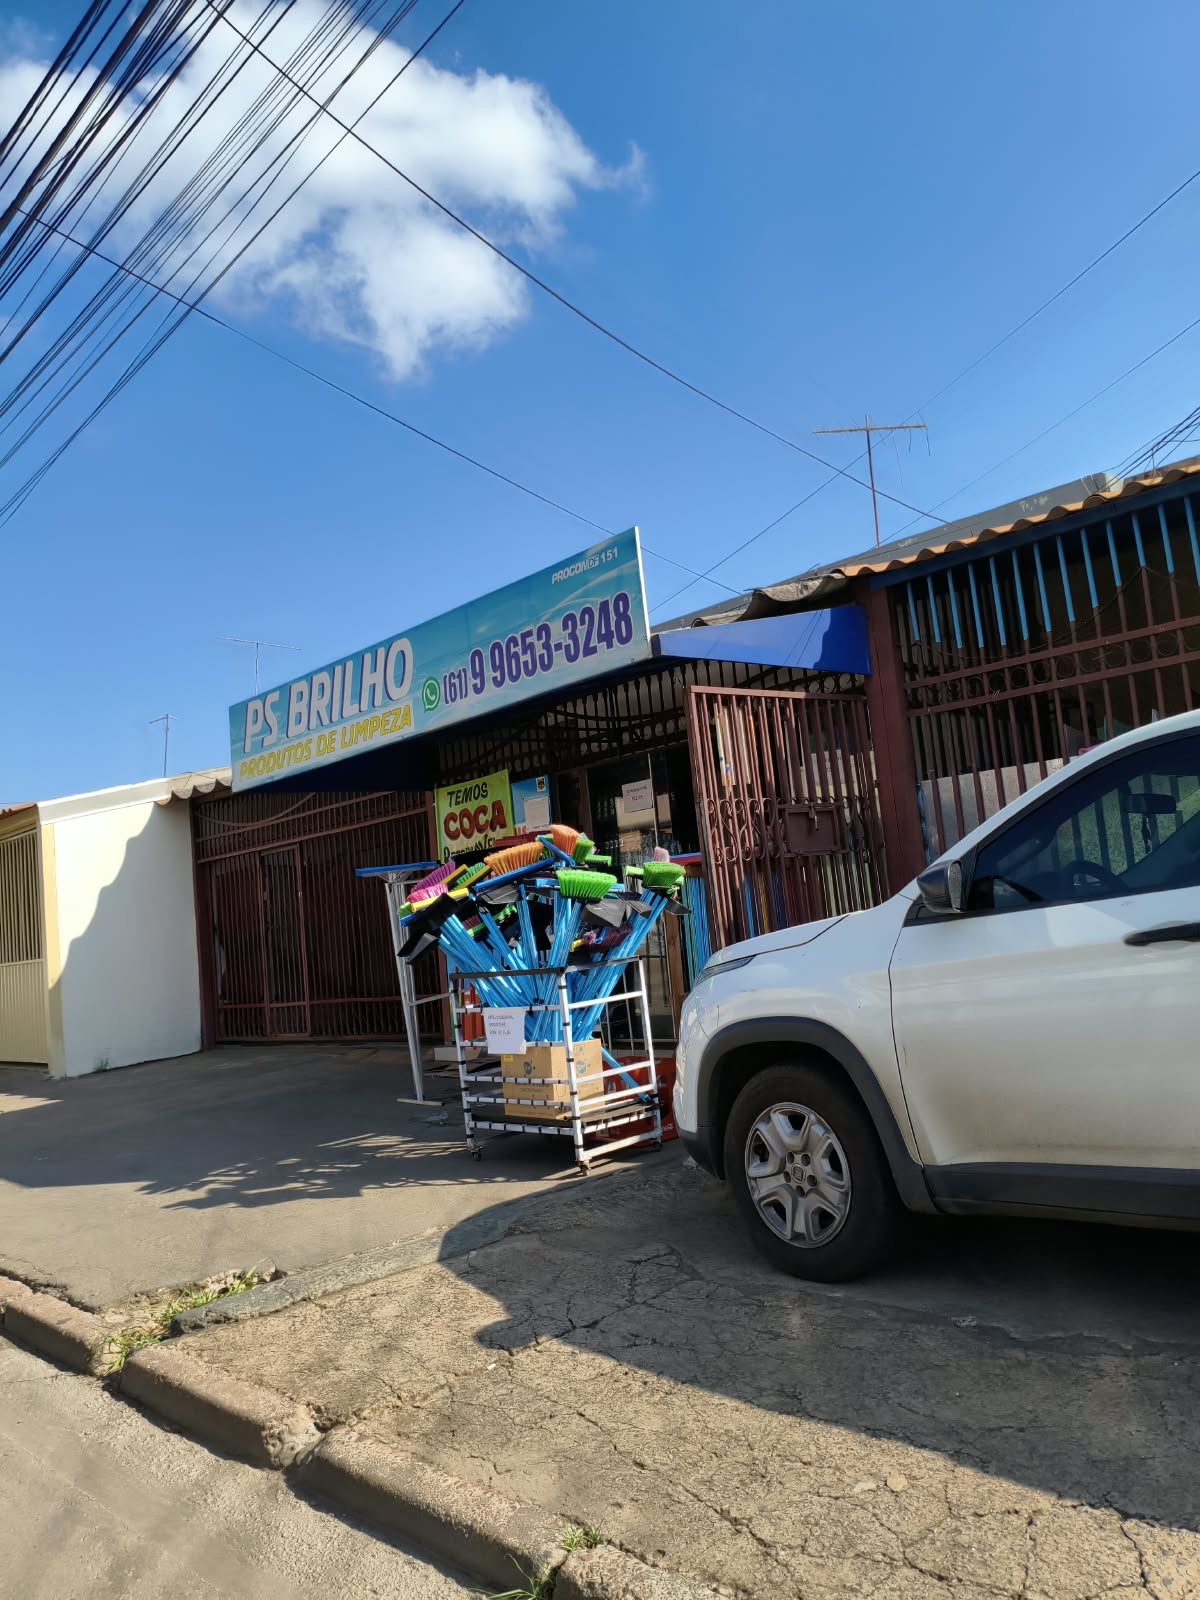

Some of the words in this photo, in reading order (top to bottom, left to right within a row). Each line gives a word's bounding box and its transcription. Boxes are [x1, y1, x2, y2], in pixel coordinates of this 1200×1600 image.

[600, 546, 618, 563] 151
[443, 667, 469, 705] (61)
[469, 648, 486, 696] 9
[489, 592, 633, 688] 9653-3248
[243, 690, 279, 753] PS
[286, 638, 413, 738] BRILHO
[239, 740, 312, 779] PRODUTOS
[317, 734, 336, 754] DE
[341, 705, 411, 748] LIMPEZA
[443, 799, 507, 841] COCA
[447, 781, 489, 808] TEMOS
